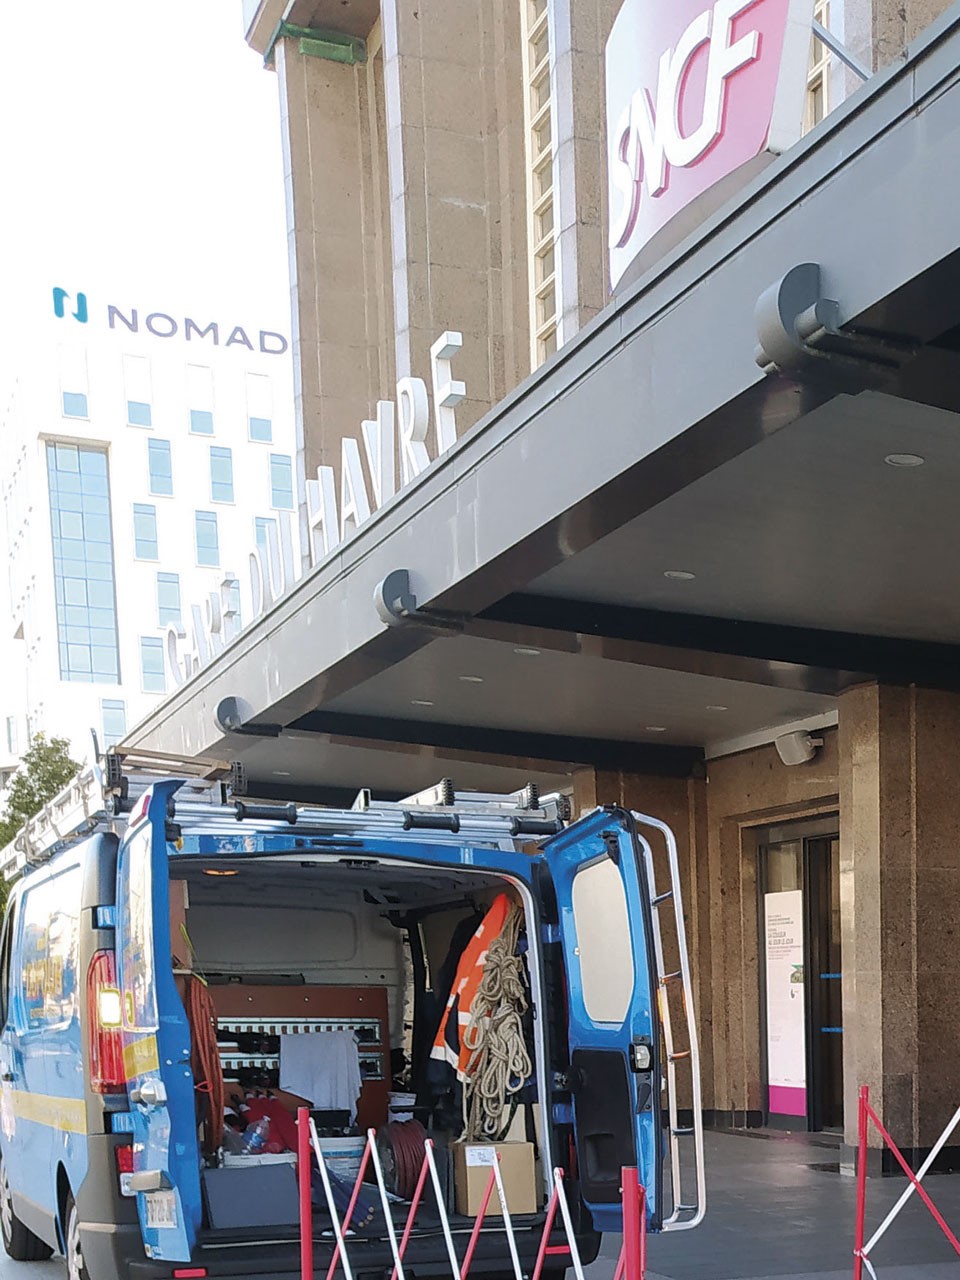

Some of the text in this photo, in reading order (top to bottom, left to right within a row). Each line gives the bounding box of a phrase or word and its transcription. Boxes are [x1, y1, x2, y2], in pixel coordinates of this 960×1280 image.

[609, 0, 765, 248] SNCF
[107, 304, 289, 355] NOMAD
[247, 510, 303, 621] DU
[305, 331, 467, 568] HAVRE
